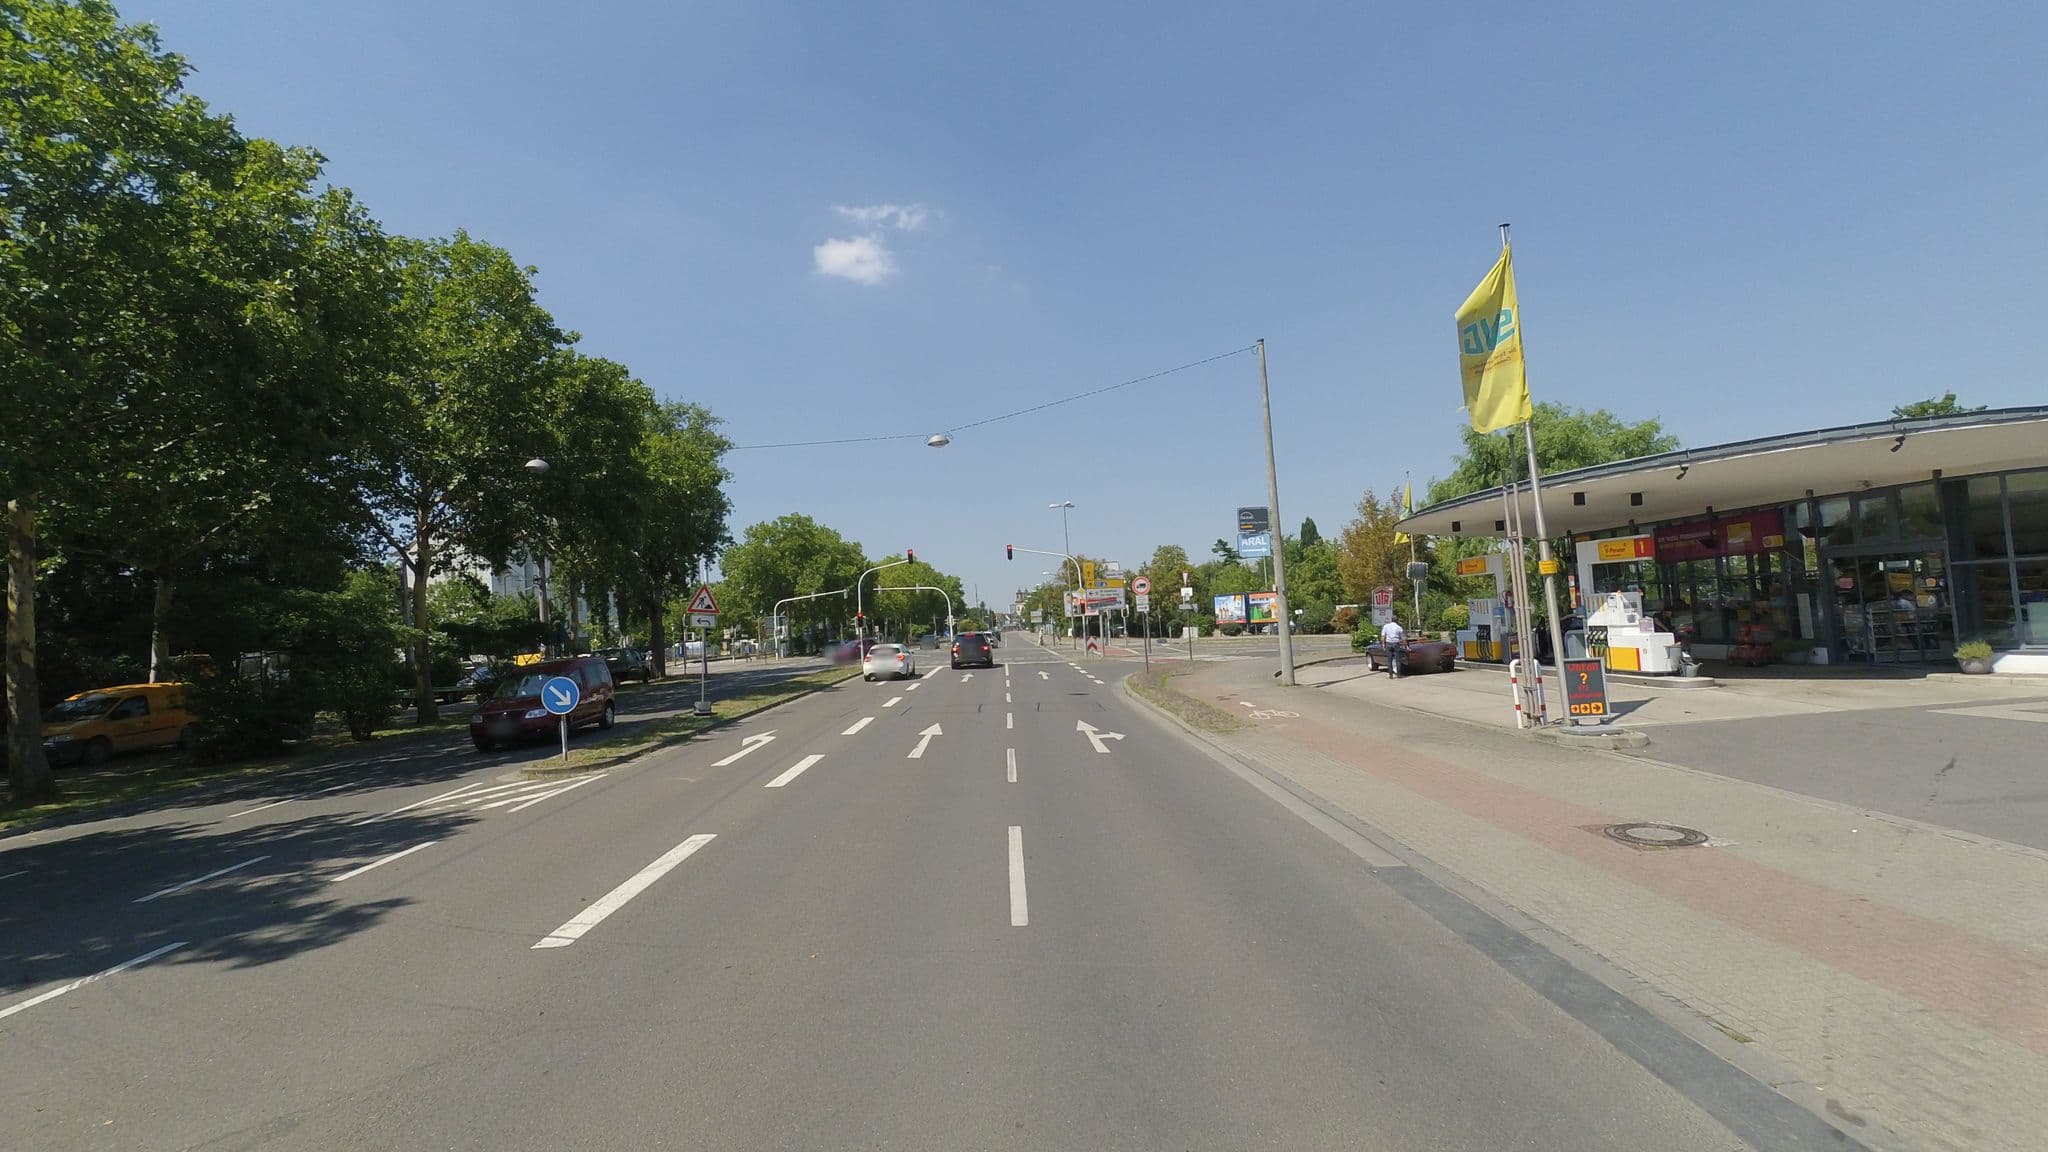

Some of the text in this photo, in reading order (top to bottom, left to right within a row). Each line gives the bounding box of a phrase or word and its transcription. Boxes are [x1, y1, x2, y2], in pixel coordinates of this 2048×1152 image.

[1241, 536, 1267, 546] ARAL
[1638, 541, 1645, 554] 1
[1579, 672, 1588, 684] ?
